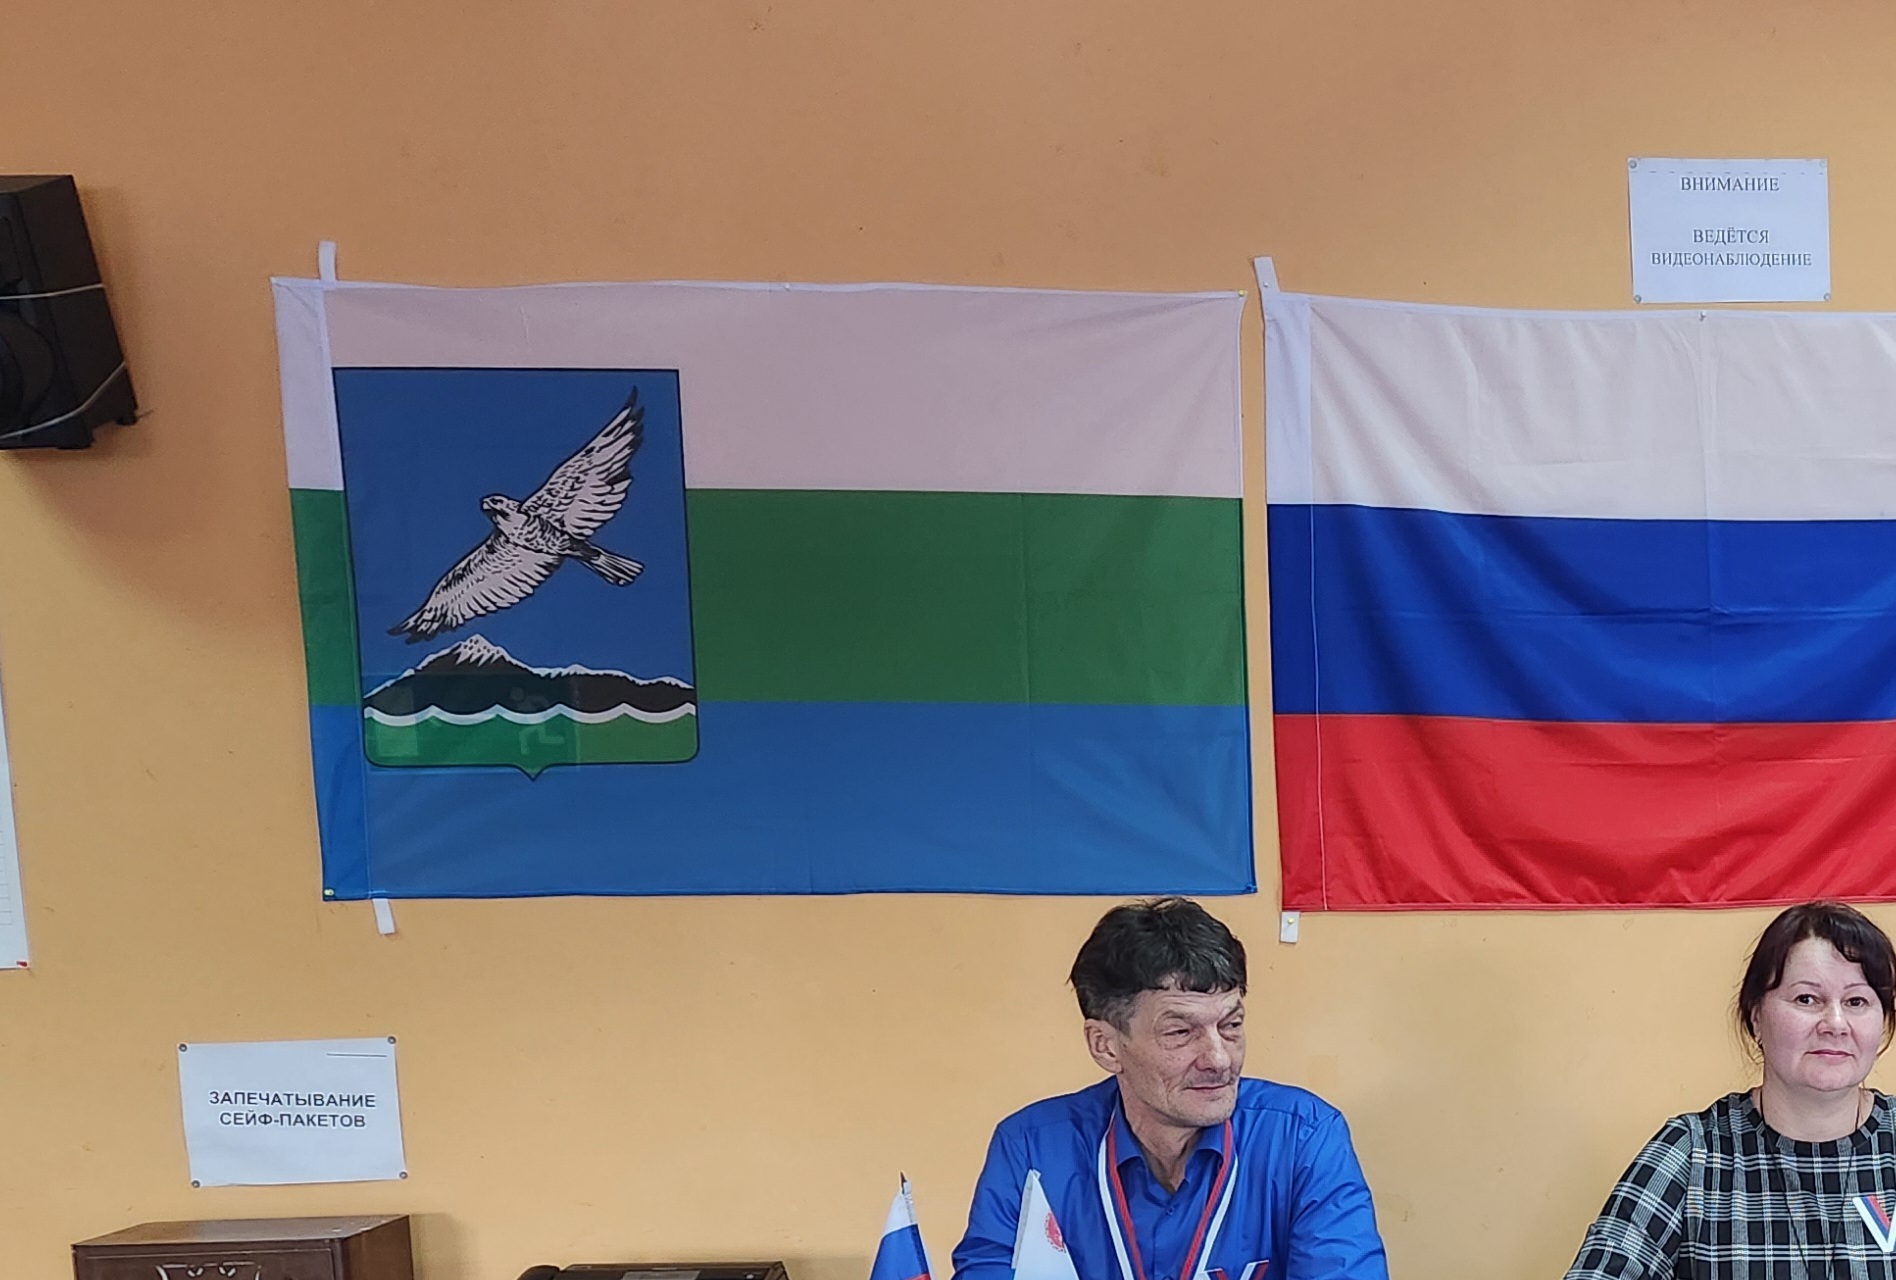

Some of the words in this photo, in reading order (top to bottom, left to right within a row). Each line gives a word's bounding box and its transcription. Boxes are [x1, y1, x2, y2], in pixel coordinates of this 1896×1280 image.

[1681, 177, 1779, 191] ВНИМАНИЕ
[1693, 227, 1769, 246] ВЕДЁТСЯ
[1651, 252, 1812, 268] ВИДЕОНАБЛЮДЕНИЕ
[209, 1091, 376, 1108] ЗАПЕЧАТЫВАНИЕ
[219, 1110, 366, 1128] СЕЙФ-ПАКЕТОВ
